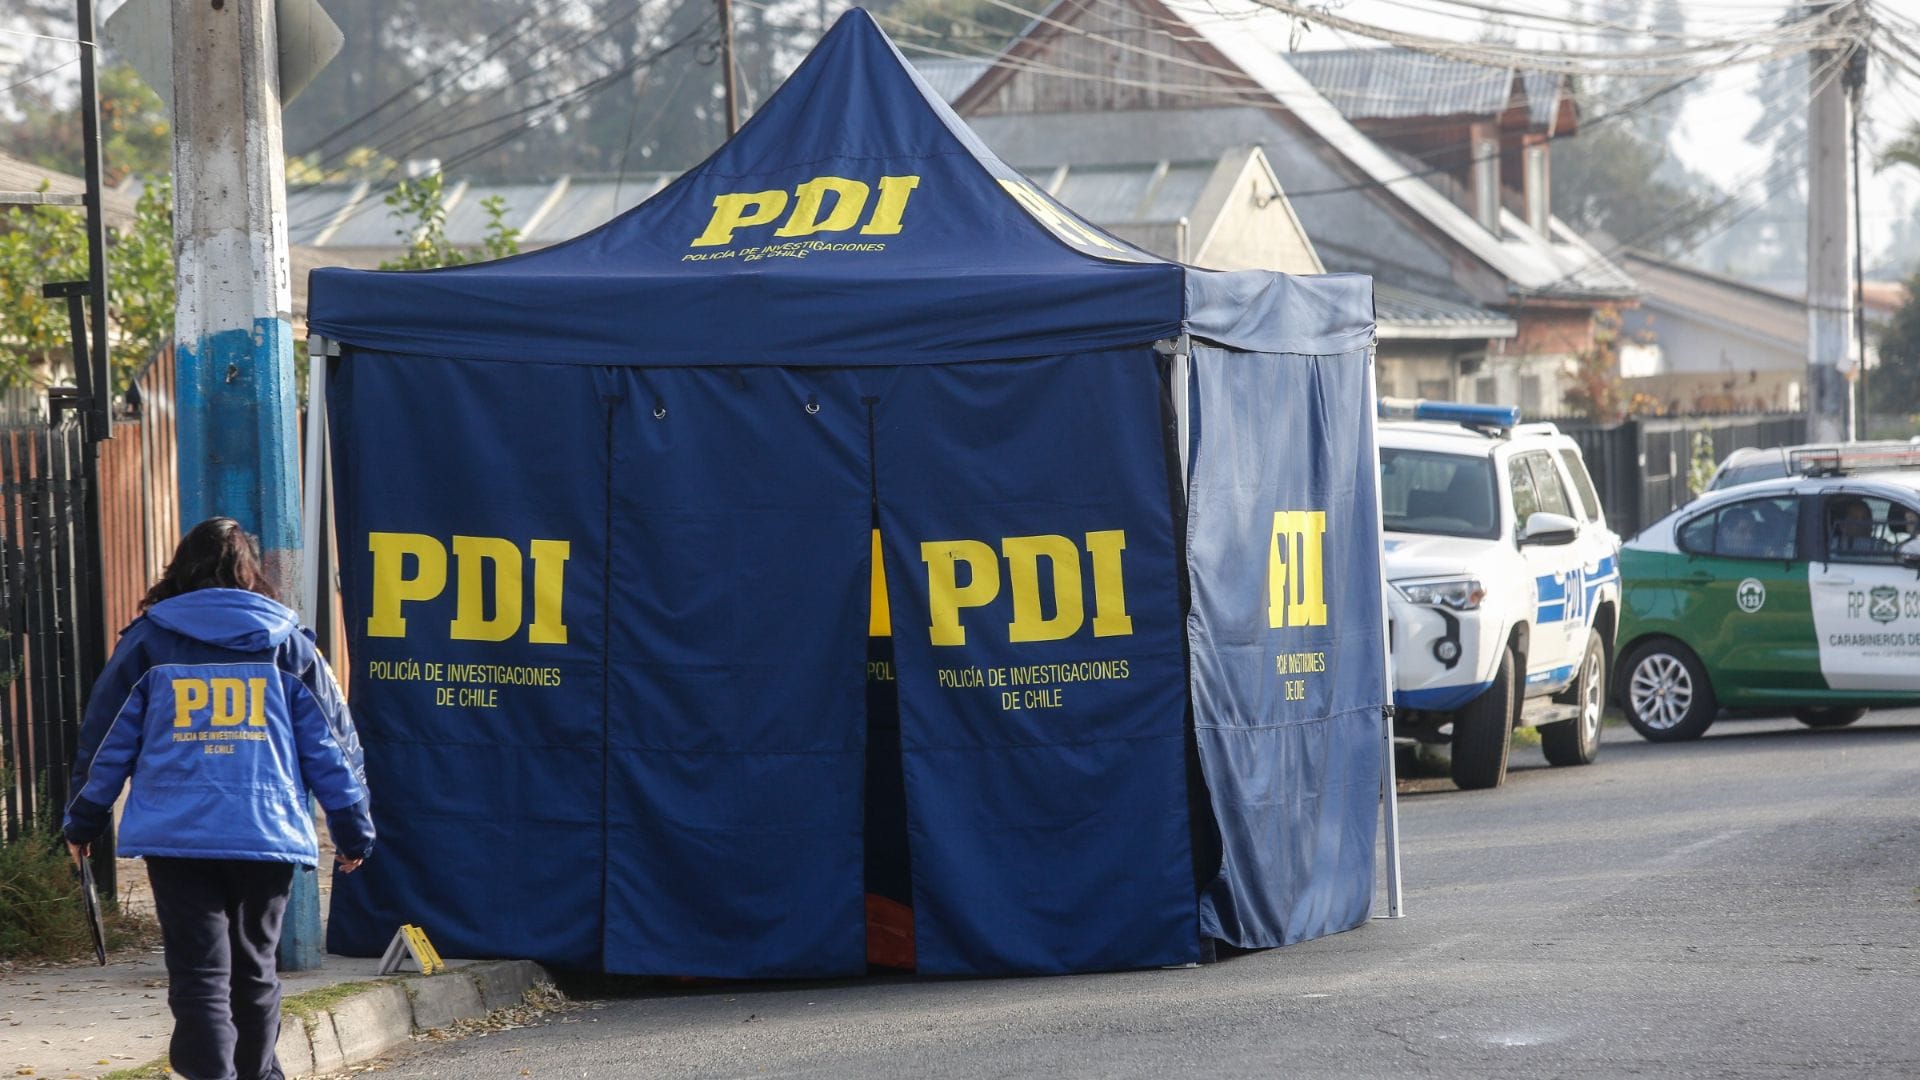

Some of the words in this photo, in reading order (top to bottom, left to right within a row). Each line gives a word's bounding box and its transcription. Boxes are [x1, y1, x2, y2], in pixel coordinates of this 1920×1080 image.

[690, 175, 920, 247] PDI
[739, 246, 760, 257] DE
[762, 240, 886, 254] INVESTIGACIONES
[744, 252, 763, 262] DE
[767, 249, 809, 259] CHILE
[367, 532, 570, 645] PDI
[920, 529, 1133, 646] PDI
[1847, 590, 1865, 618] RP
[1828, 633, 1906, 647] CARABINEROS
[369, 658, 420, 680] POLICÍA
[425, 663, 444, 682] DE
[448, 665, 561, 686] INVESTIGACIONES
[938, 665, 985, 688] POLICÍA
[988, 667, 1007, 687] DE
[1010, 660, 1129, 685] INVESTIGACIONES
[172, 678, 268, 728] PDI
[436, 687, 455, 706] DE
[459, 689, 498, 708] CHILE
[1002, 691, 1021, 711] DE
[1024, 688, 1063, 709] CHILE
